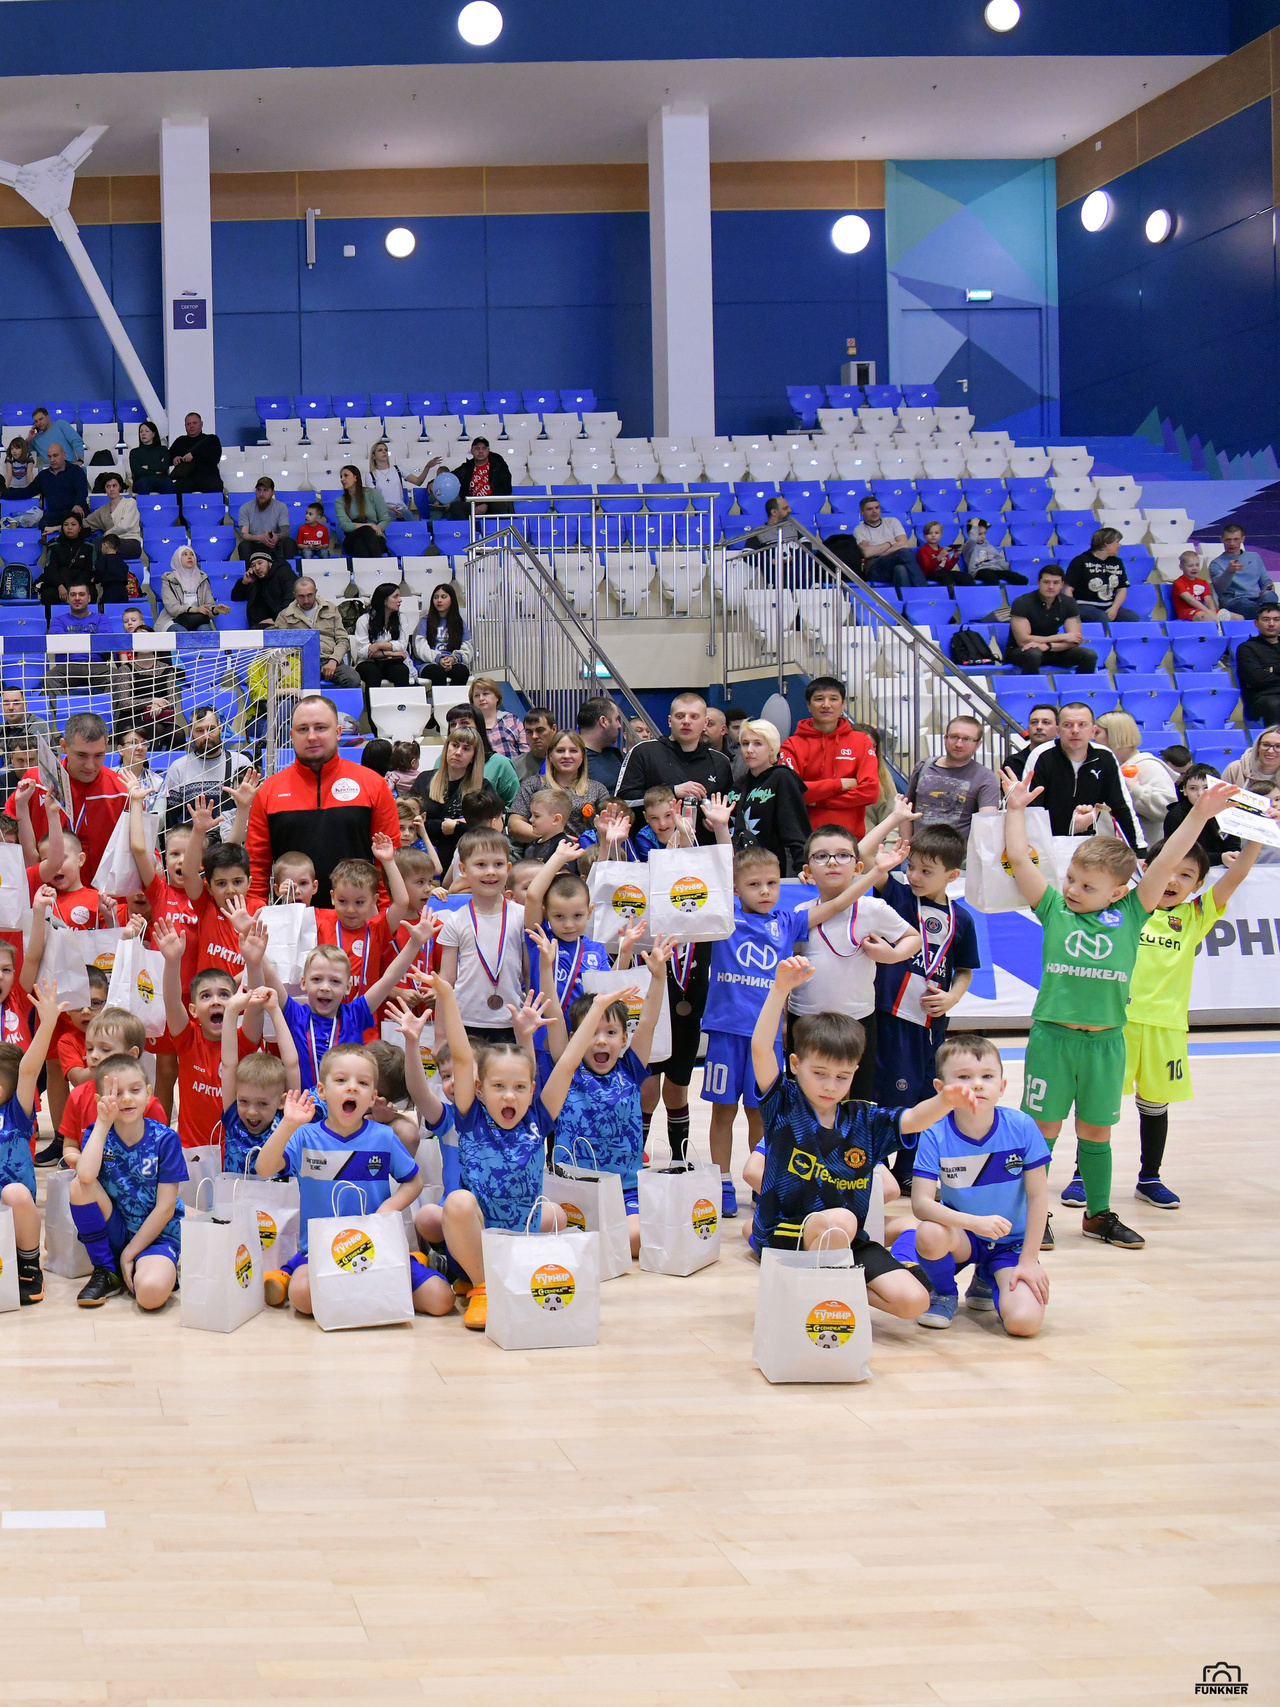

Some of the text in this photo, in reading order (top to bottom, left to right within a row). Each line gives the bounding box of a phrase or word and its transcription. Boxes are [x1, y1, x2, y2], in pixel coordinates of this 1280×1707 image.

[1046, 962, 1128, 983] НОРНИКЕЛЬ
[705, 1061, 729, 1096] 10
[1165, 1058, 1184, 1081] 10
[1025, 1074, 1048, 1113] 12
[535, 1273, 570, 1287] ТУРНИР
[814, 1309, 852, 1321] ТУРНИР
